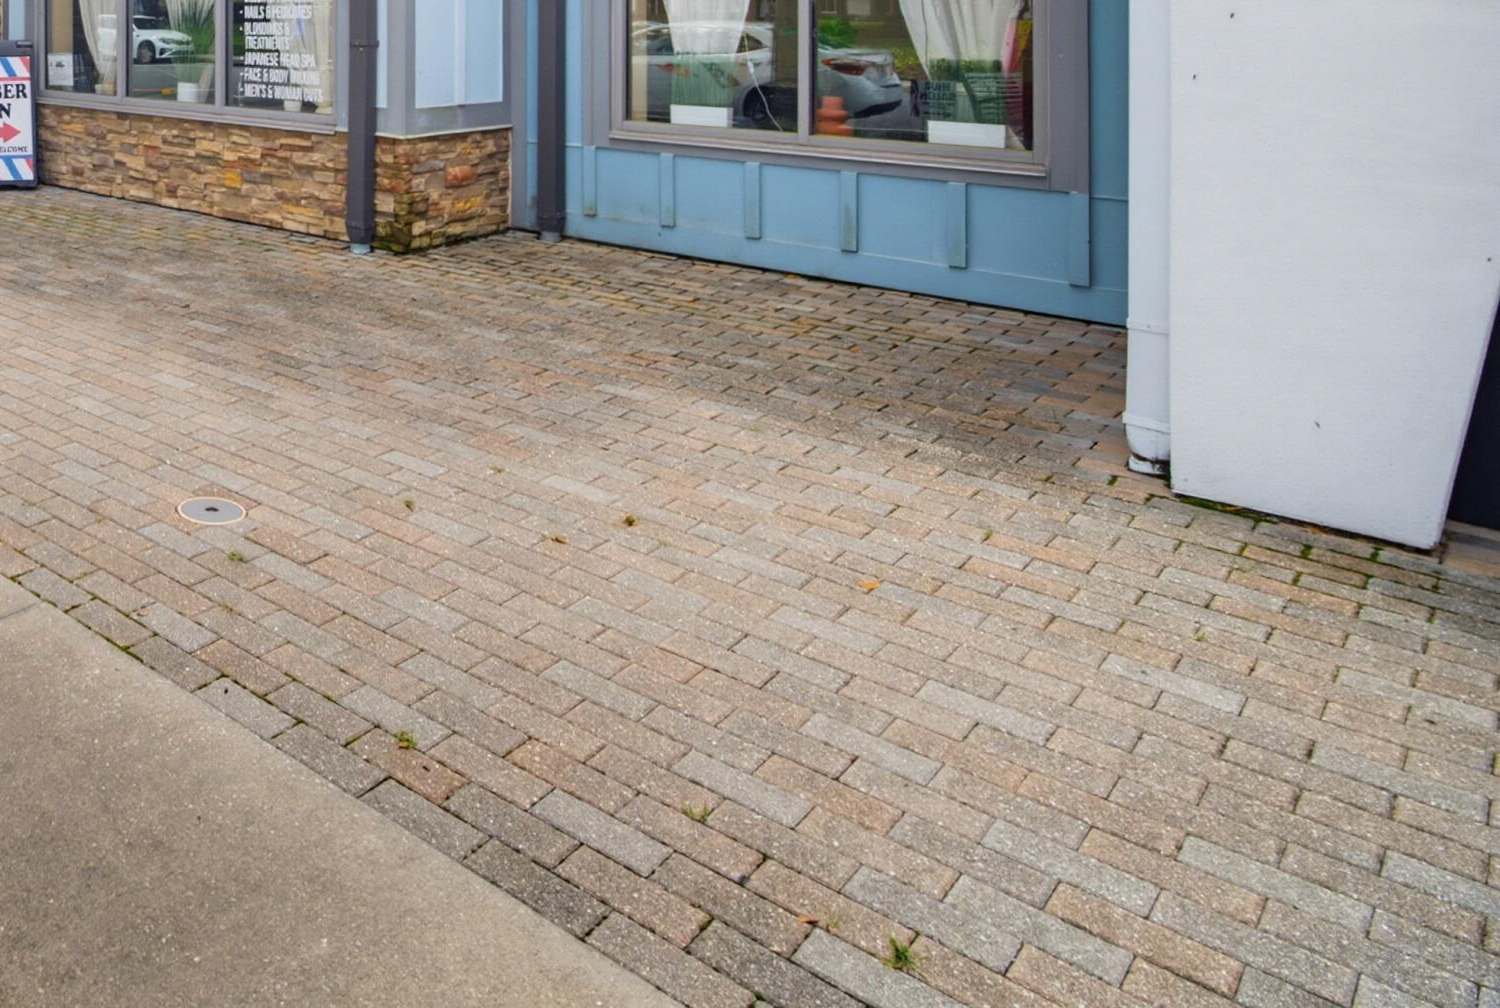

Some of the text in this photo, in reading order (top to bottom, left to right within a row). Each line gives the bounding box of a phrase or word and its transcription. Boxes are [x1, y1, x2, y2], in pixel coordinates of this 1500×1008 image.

[244, 5, 264, 19] NAILS
[245, 36, 290, 50] TREATMENTS
[244, 51, 317, 69] JAPANESE HEAD SPA
[244, 67, 261, 81] FACE
[269, 69, 288, 83] BODY
[244, 83, 266, 98] MEN'S
